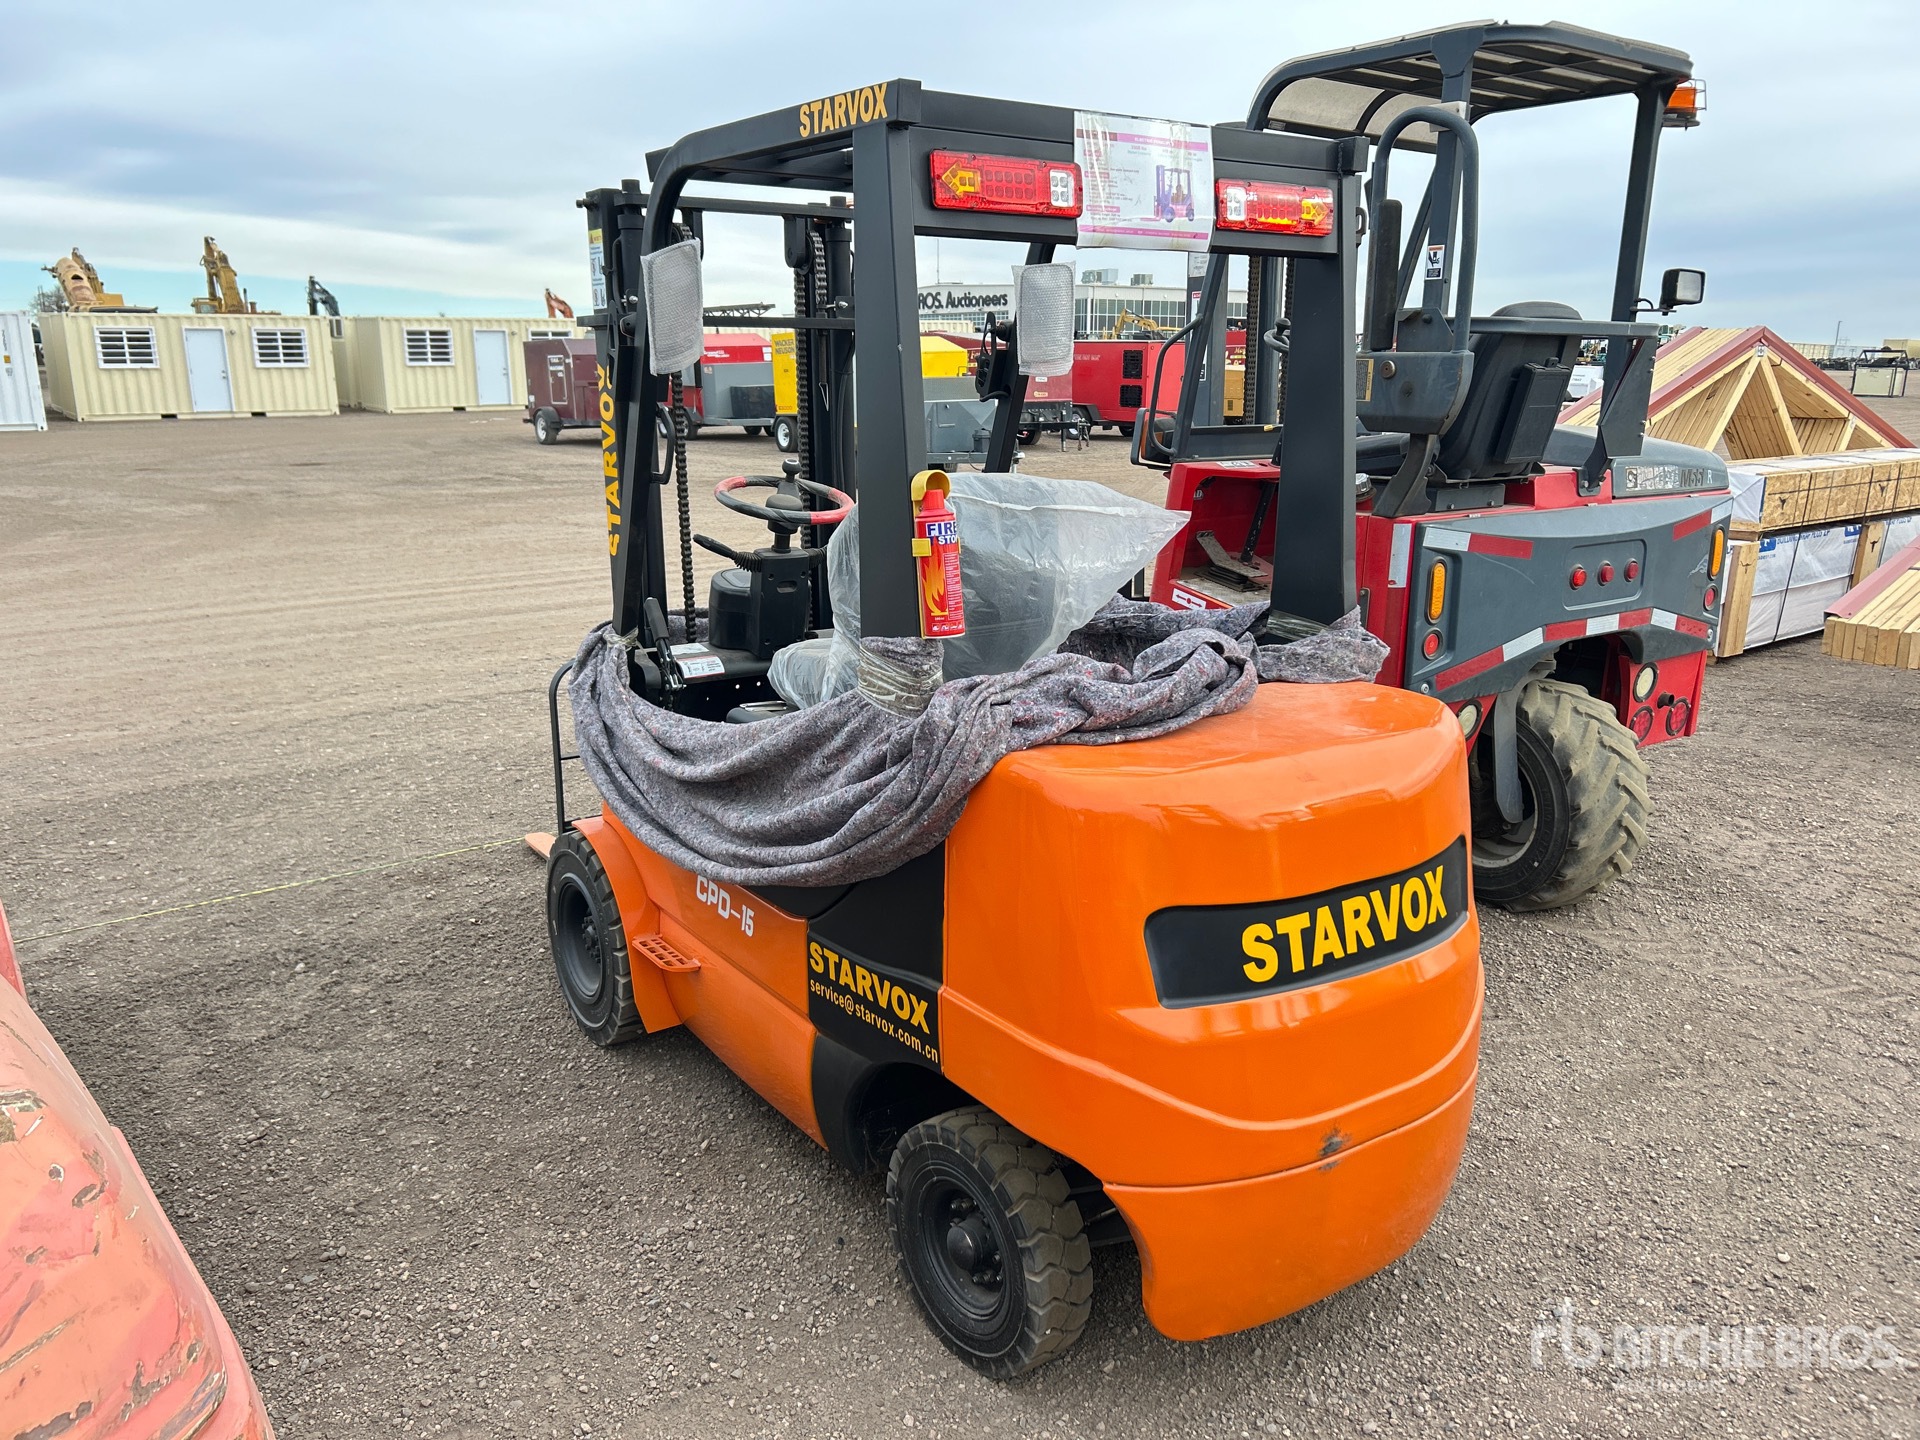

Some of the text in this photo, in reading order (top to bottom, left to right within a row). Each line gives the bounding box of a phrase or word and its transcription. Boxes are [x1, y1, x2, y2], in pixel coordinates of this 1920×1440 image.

[799, 82, 888, 138] STARVOX
[945, 291, 1008, 309] Auctioneers
[926, 521, 957, 535] FIRE
[696, 875, 755, 937] CPD-15
[1242, 865, 1448, 983] STARVOX
[809, 941, 930, 1035] STARVOX
